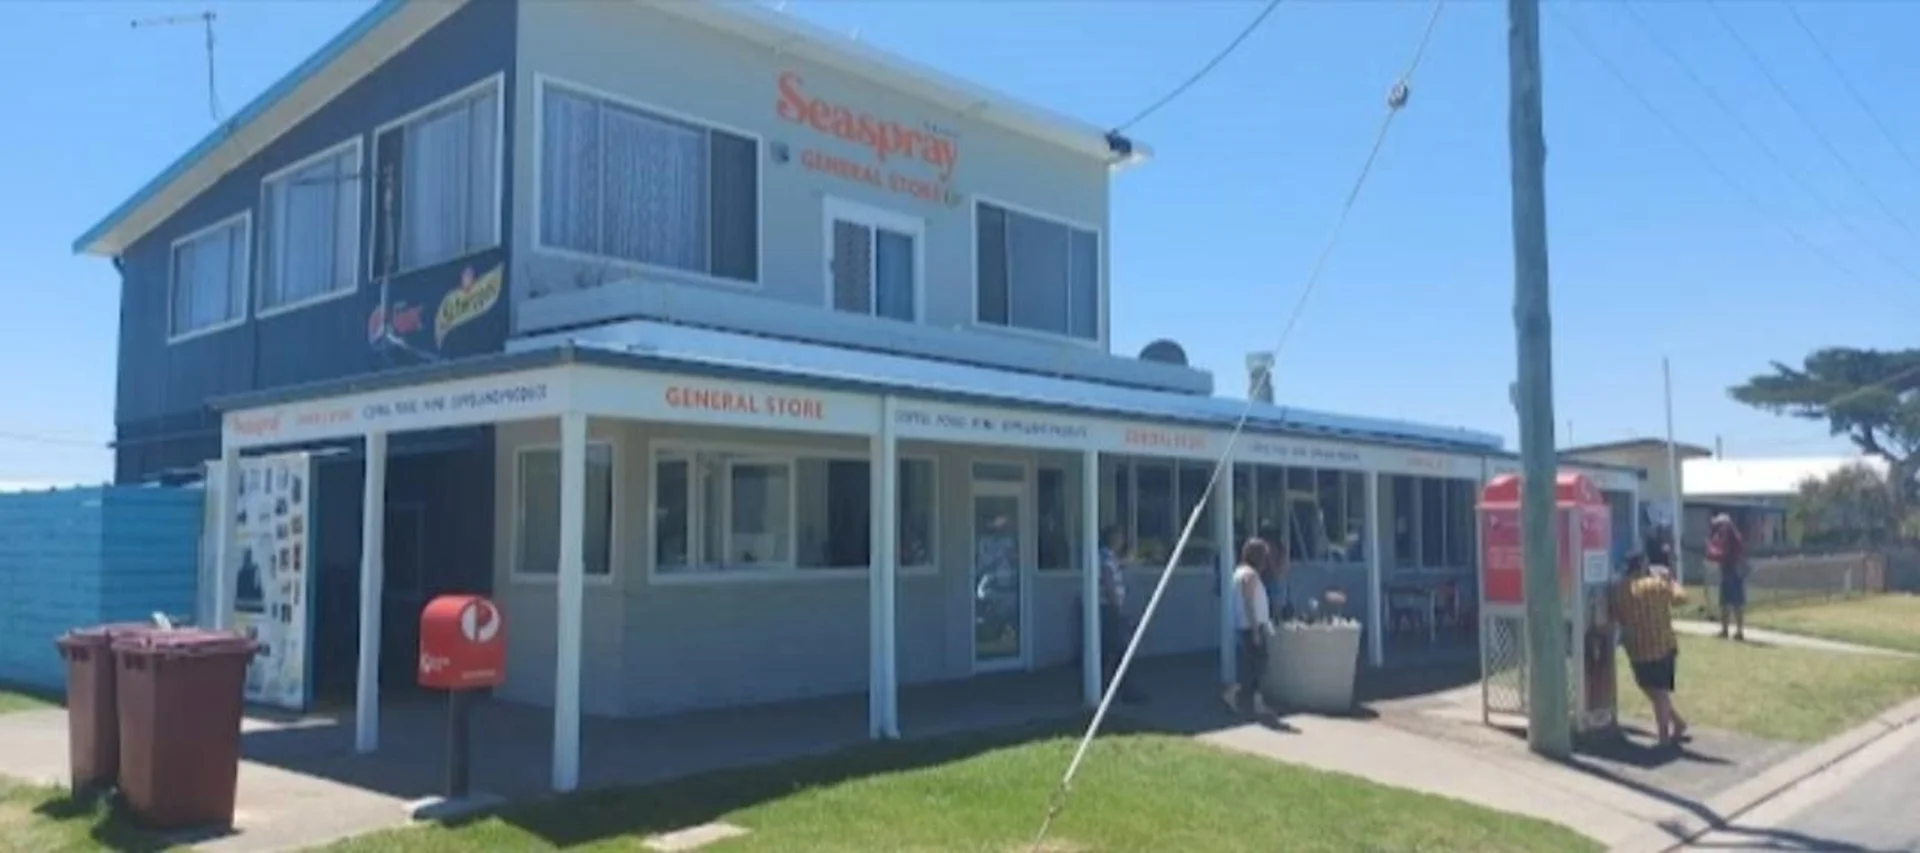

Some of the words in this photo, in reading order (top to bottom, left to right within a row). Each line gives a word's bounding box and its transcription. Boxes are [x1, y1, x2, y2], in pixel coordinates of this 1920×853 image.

[777, 71, 957, 181] Seaspray
[801, 148, 882, 187] GENERAL
[888, 172, 943, 200] STORE
[666, 387, 758, 413] GENERAL
[765, 396, 823, 420] STORE
